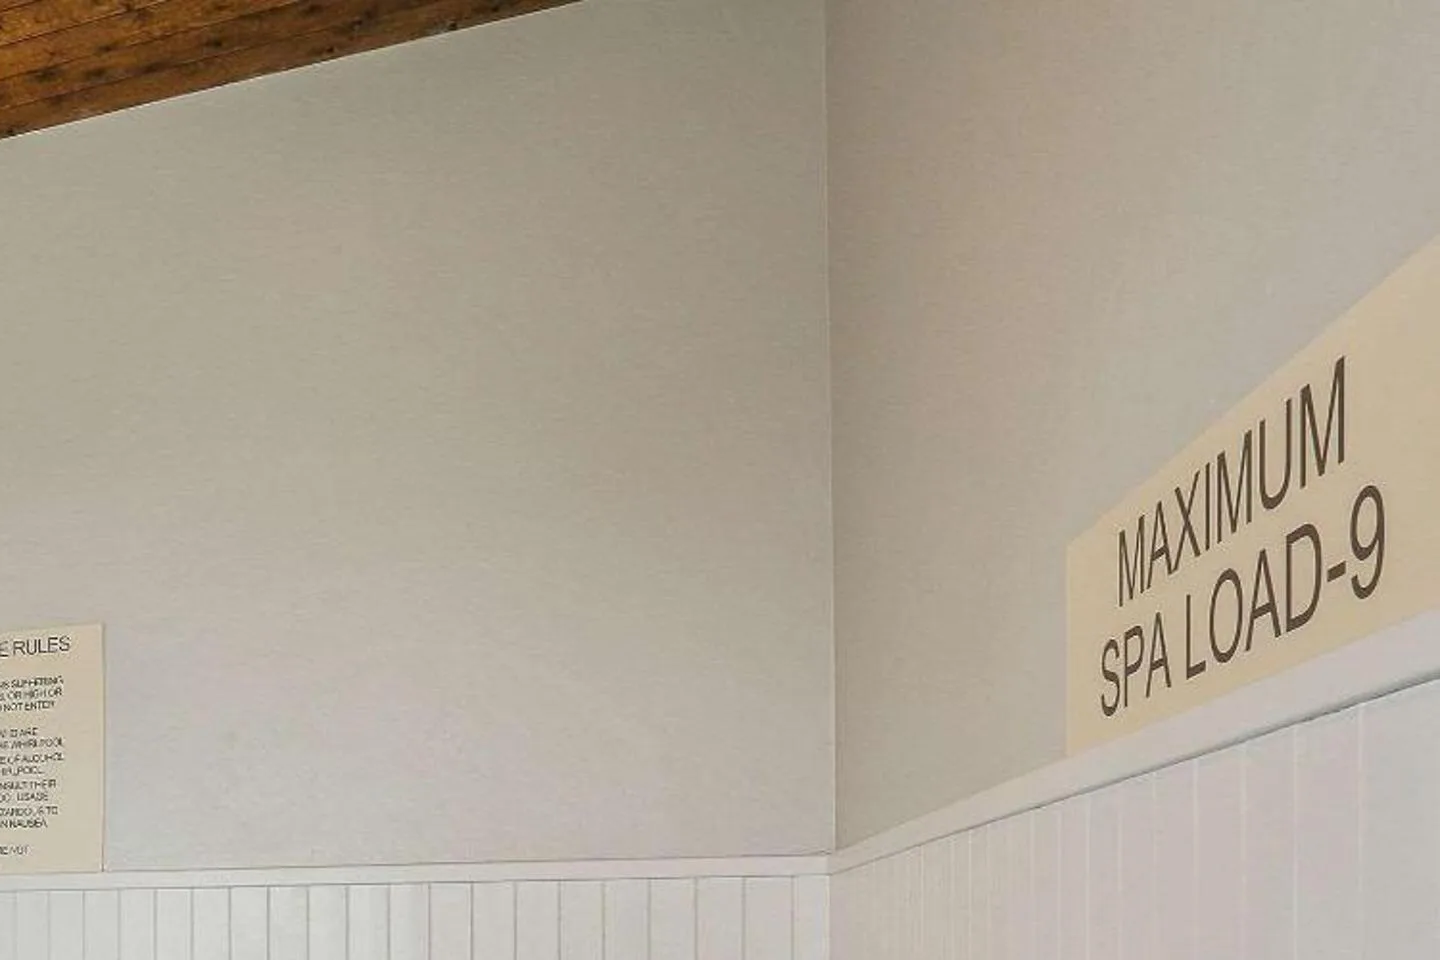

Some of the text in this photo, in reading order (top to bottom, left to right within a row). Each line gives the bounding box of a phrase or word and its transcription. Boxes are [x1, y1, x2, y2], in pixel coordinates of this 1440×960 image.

[1117, 354, 1346, 607] MAXIMUM
[13, 635, 71, 656] RULES
[1100, 484, 1386, 717] SPA LOAD-9
